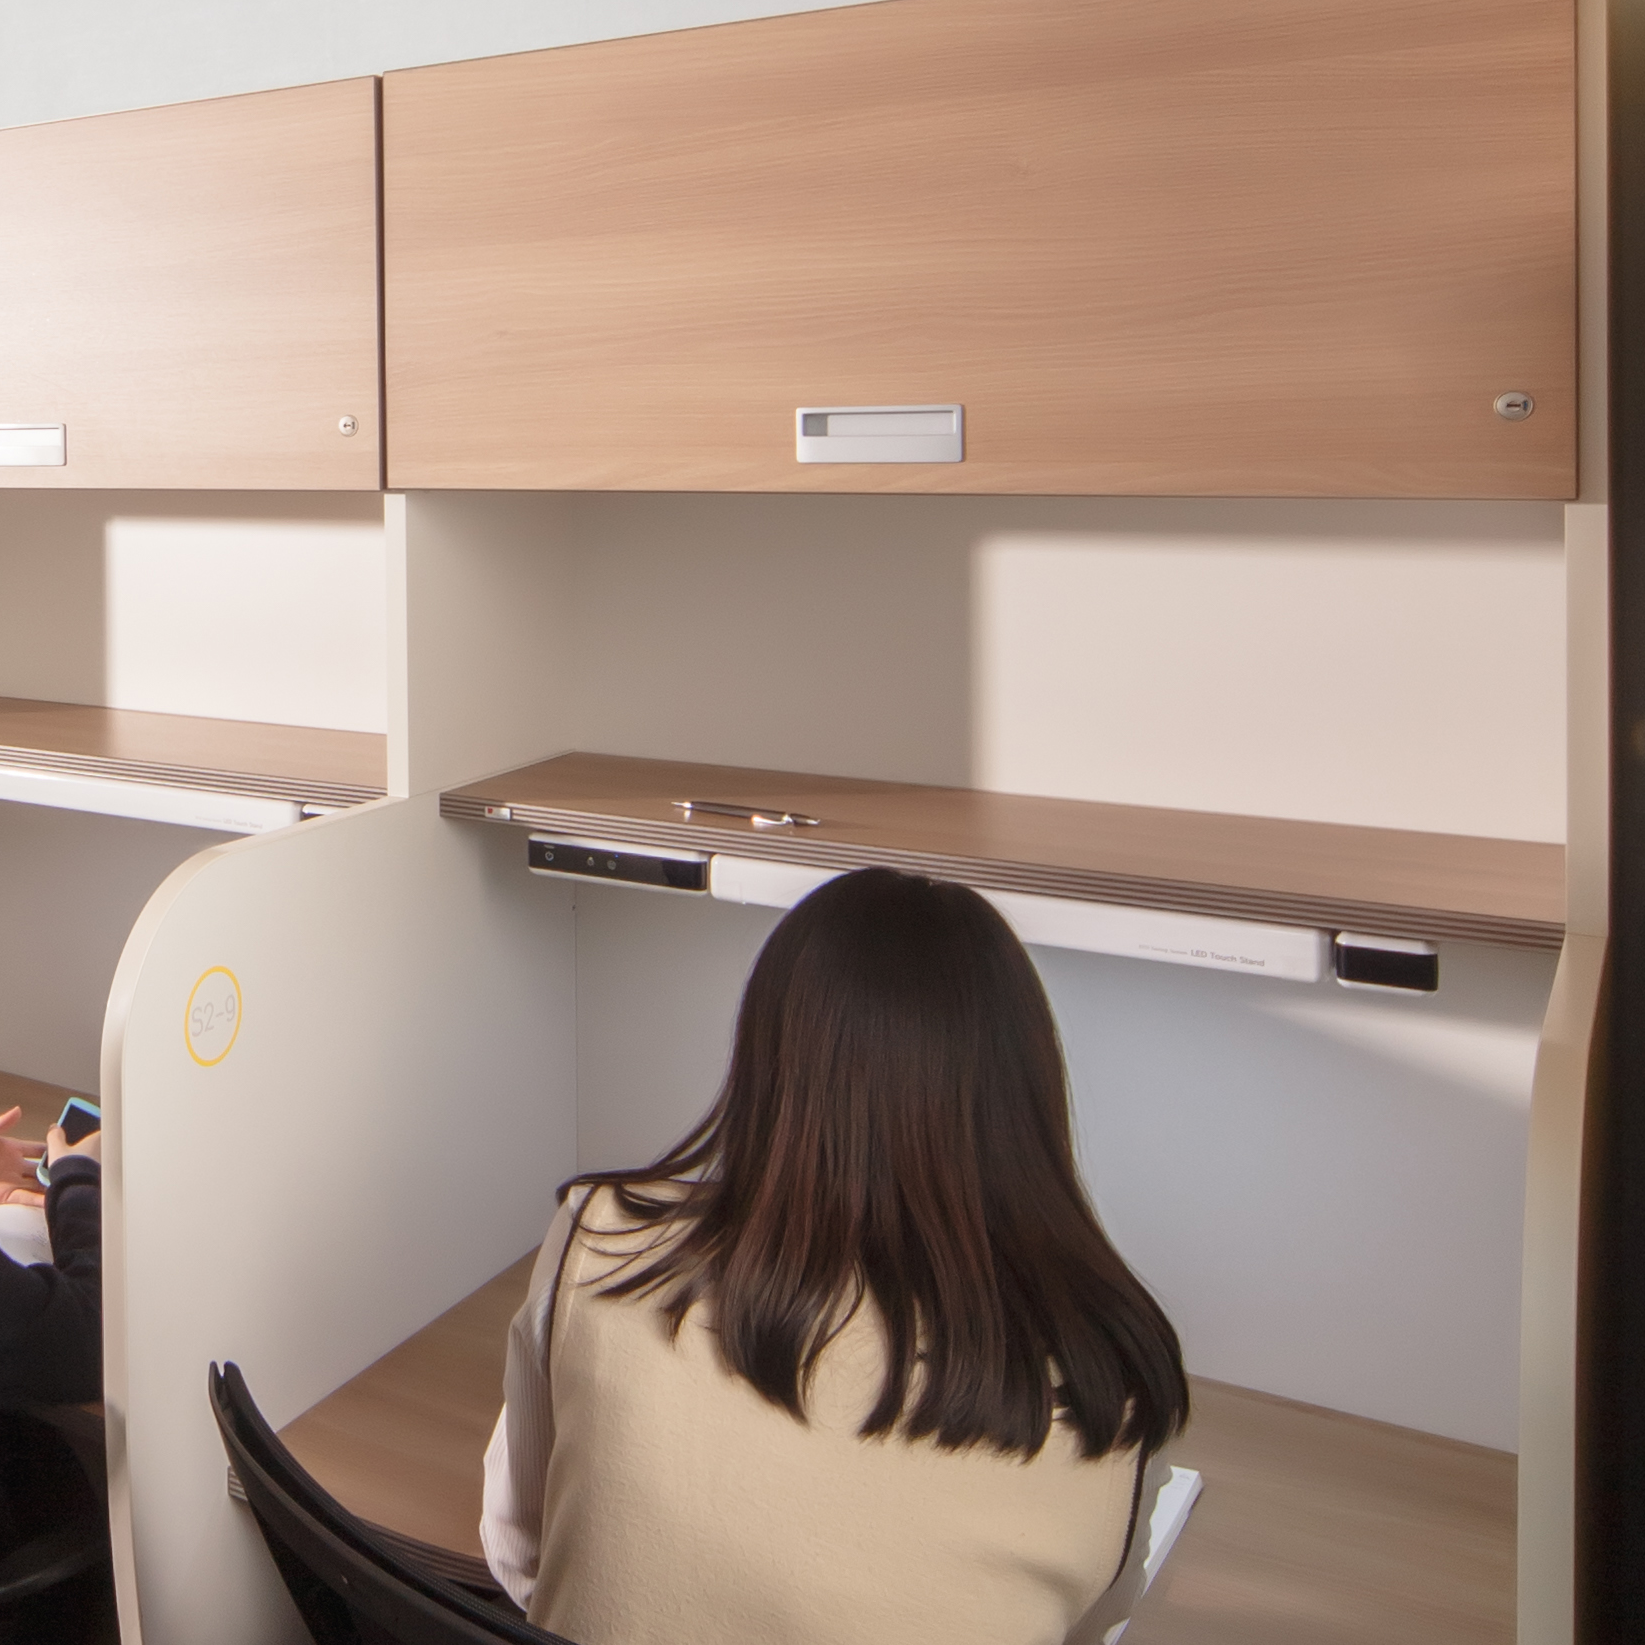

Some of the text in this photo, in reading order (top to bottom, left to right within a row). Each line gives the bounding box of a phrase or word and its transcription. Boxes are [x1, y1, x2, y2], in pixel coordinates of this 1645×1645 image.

[1191, 949, 1208, 959] LED
[1210, 952, 1237, 963] Touch
[1240, 956, 1265, 967] Stand
[191, 993, 236, 1038] S2-9
